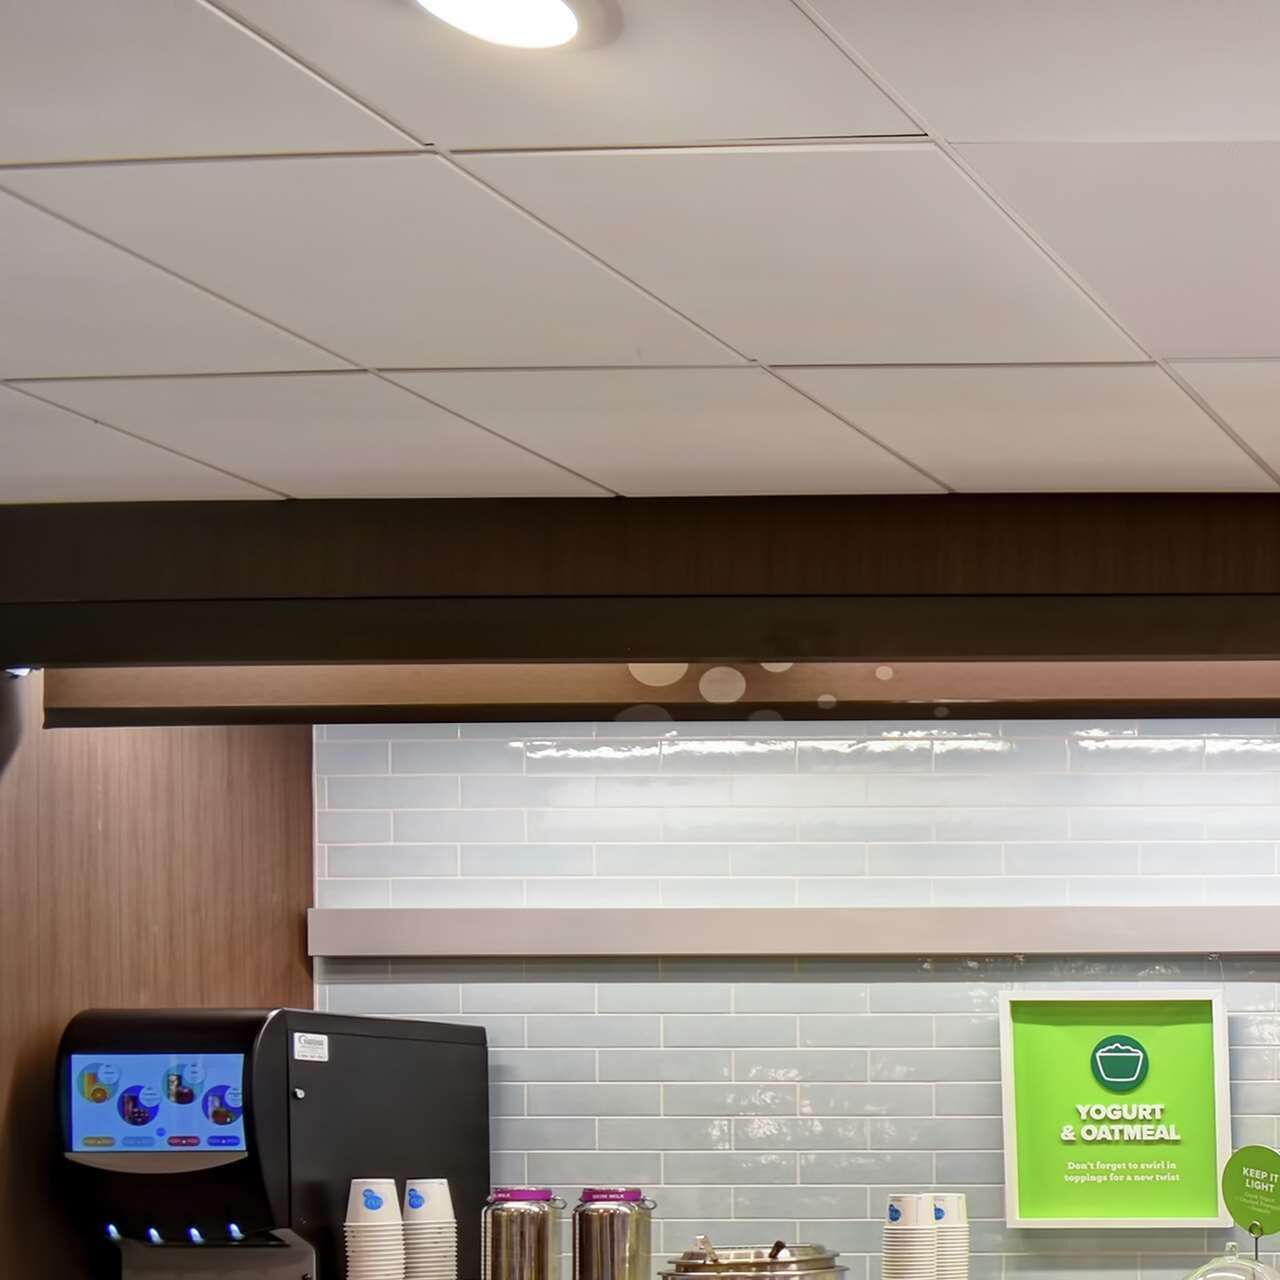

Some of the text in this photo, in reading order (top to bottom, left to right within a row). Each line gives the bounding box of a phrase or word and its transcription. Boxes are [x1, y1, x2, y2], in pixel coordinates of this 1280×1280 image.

[1075, 1104, 1165, 1120] YOGURT
[1060, 1125, 1181, 1140] & OATMEAL
[1068, 1161, 1094, 1169] Don't
[1096, 1161, 1126, 1171] forget
[1140, 1161, 1165, 1169] swirl
[1167, 1161, 1177, 1169] in
[1064, 1173, 1107, 1183] toppings
[1109, 1172, 1125, 1182] for
[1156, 1172, 1180, 1181] twist
[1242, 1166, 1279, 1183] KEEP IT
[1245, 1179, 1275, 1193] LIGHT
